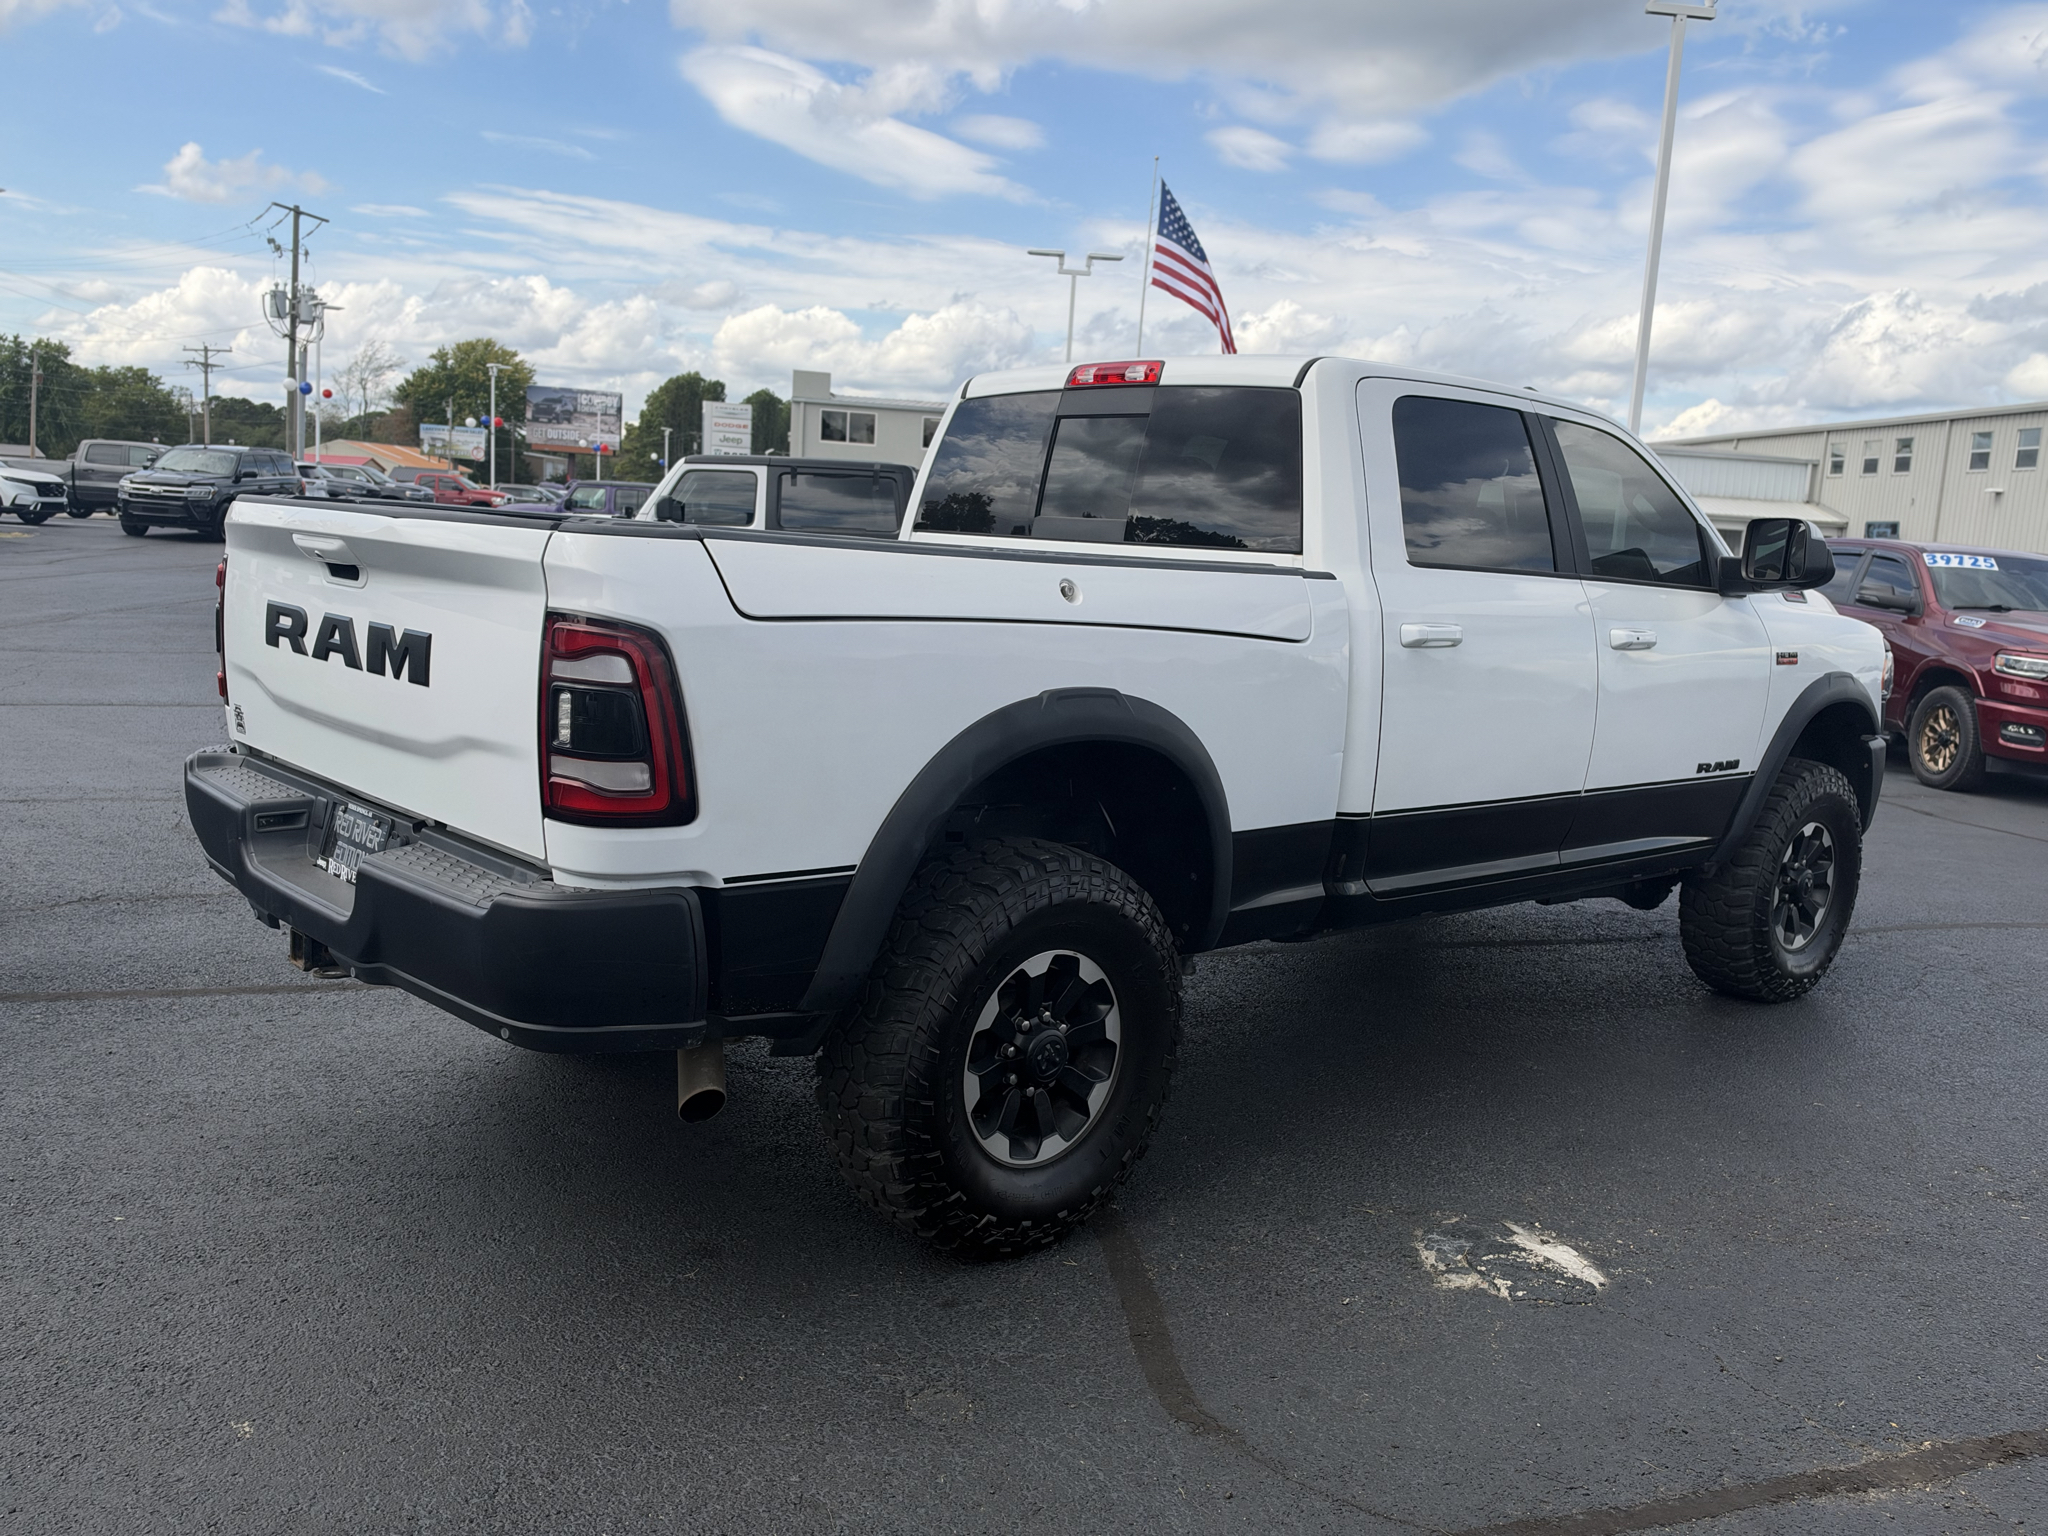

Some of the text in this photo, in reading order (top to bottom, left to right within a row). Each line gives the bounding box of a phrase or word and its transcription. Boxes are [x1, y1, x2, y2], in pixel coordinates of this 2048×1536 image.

[533, 428, 546, 437] GET
[547, 428, 580, 440] OUTSIDE
[719, 434, 743, 445] Jeep
[1926, 553, 1995, 569] 39725
[265, 599, 433, 688] RAM
[1696, 759, 1740, 774] RAM
[334, 811, 382, 851] RED RIVER
[328, 858, 340, 876] RED
[340, 863, 357, 883] RIVE
